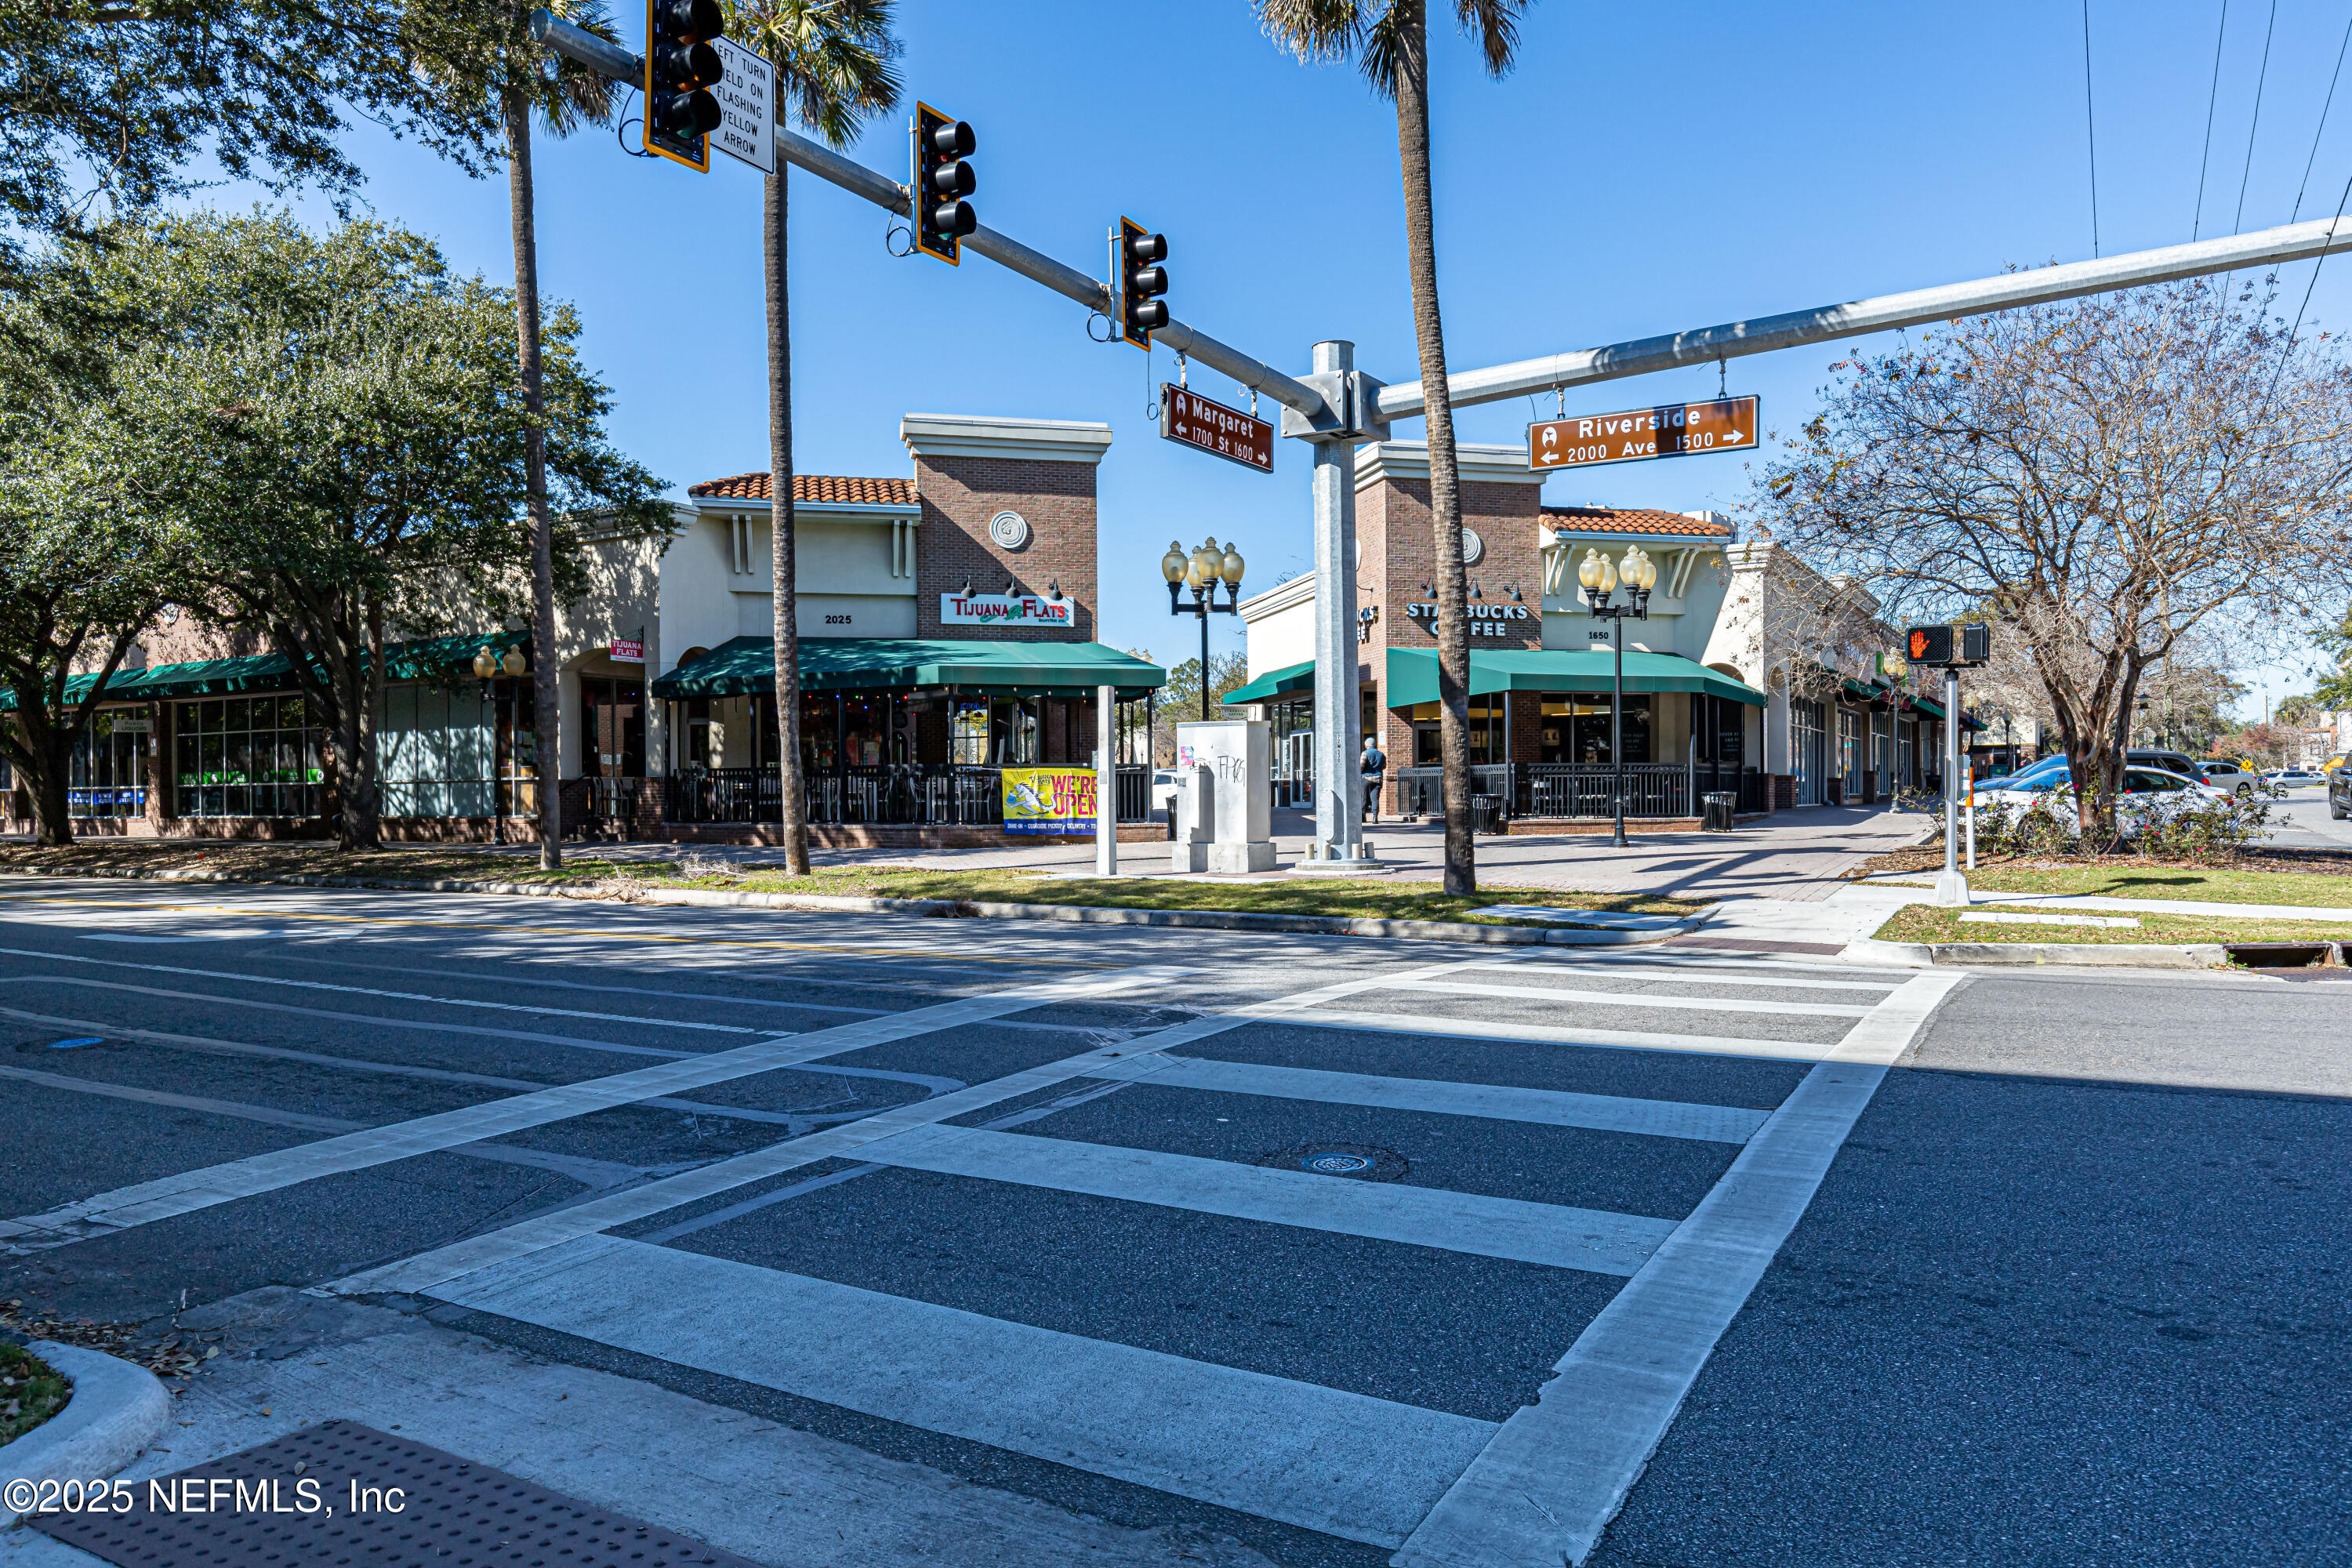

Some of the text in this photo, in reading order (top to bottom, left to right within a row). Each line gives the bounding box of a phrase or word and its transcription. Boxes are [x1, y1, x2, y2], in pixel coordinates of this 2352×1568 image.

[742, 57, 766, 82] TURN
[722, 67, 763, 100] IELD ON
[717, 86, 762, 119] FLASHING
[721, 107, 758, 137] YELLOW
[724, 130, 756, 156] ARROW
[1192, 397, 1253, 438] Margaret
[1579, 408, 1700, 439] Riverside
[1192, 426, 1253, 461] 1700 St 1600
[1568, 432, 1713, 463] 2000 Ave 1500
[825, 615, 852, 624] 2025
[950, 598, 1065, 618] TIJUANA FLATS
[1406, 603, 1528, 619] STABUCKS
[1429, 621, 1505, 636] CFEE
[1588, 631, 1609, 640] 1650
[612, 640, 641, 650] TIJUANA
[616, 648, 637, 657] FLATS
[1051, 775, 1097, 794] WE'RE
[1054, 793, 1097, 815] OPEN
